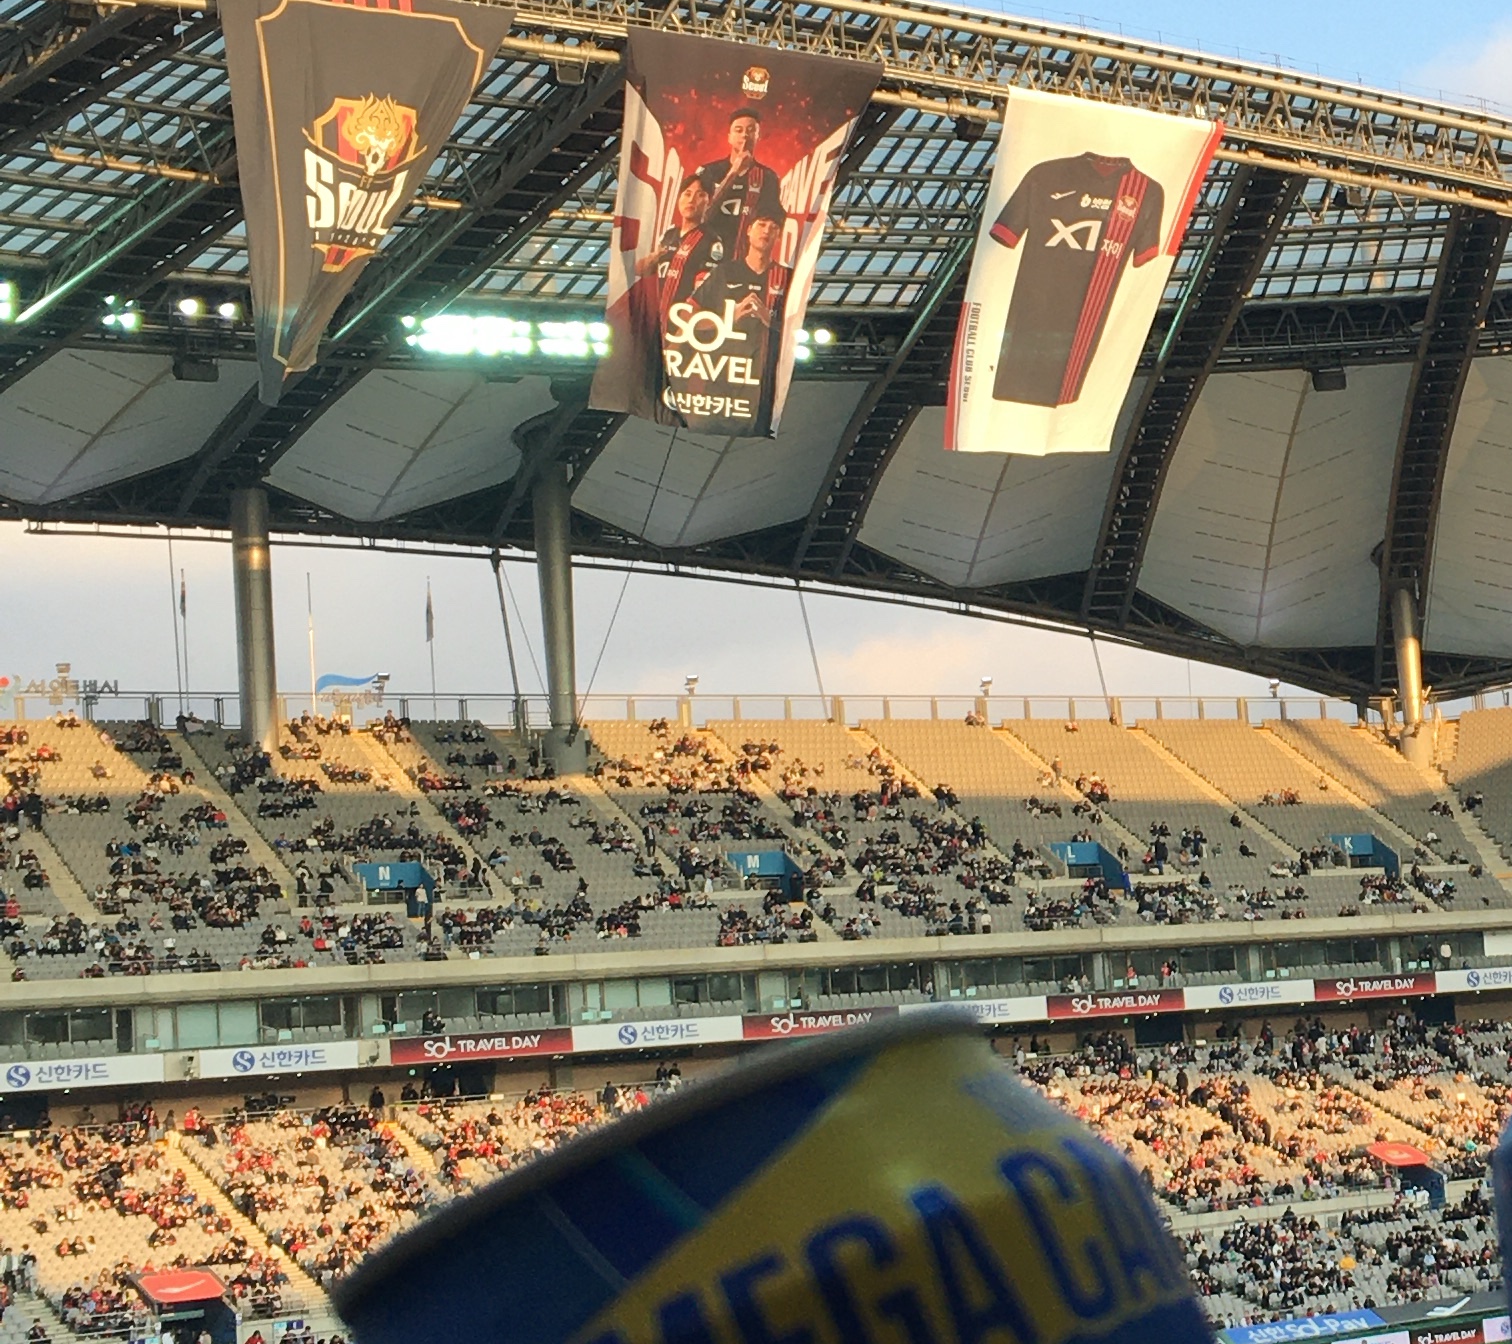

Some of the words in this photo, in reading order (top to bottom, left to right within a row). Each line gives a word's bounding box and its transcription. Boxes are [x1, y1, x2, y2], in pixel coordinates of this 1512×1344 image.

[1100, 238, 1123, 260] 자이
[665, 298, 747, 352] SOL
[676, 393, 752, 418] 신한카드
[1067, 845, 1076, 858] L
[1344, 837, 1353, 849] K
[746, 855, 760, 869] M
[378, 865, 391, 881] N
[1236, 986, 1282, 1002] 신한카드
[1336, 978, 1358, 997] SOL
[1358, 980, 1395, 992] TRAVEL
[1395, 977, 1415, 990] DAY
[1071, 994, 1096, 1014] SOL
[1097, 996, 1136, 1009] TRAVEL
[1138, 994, 1161, 1006] DAY
[641, 1023, 700, 1040] 신한카드
[771, 1012, 800, 1034] SOL
[800, 1013, 845, 1029] TRAVEL
[847, 1012, 872, 1025] DAY
[423, 1036, 455, 1058] SOL
[457, 1037, 511, 1054] TRAVEL
[512, 1034, 541, 1049] DAY
[259, 1049, 327, 1068] 신한카드
[35, 1062, 110, 1084] 신한카드
[1434, 1331, 1460, 1344] TRAVEL
[1460, 1329, 1477, 1341] DAY
